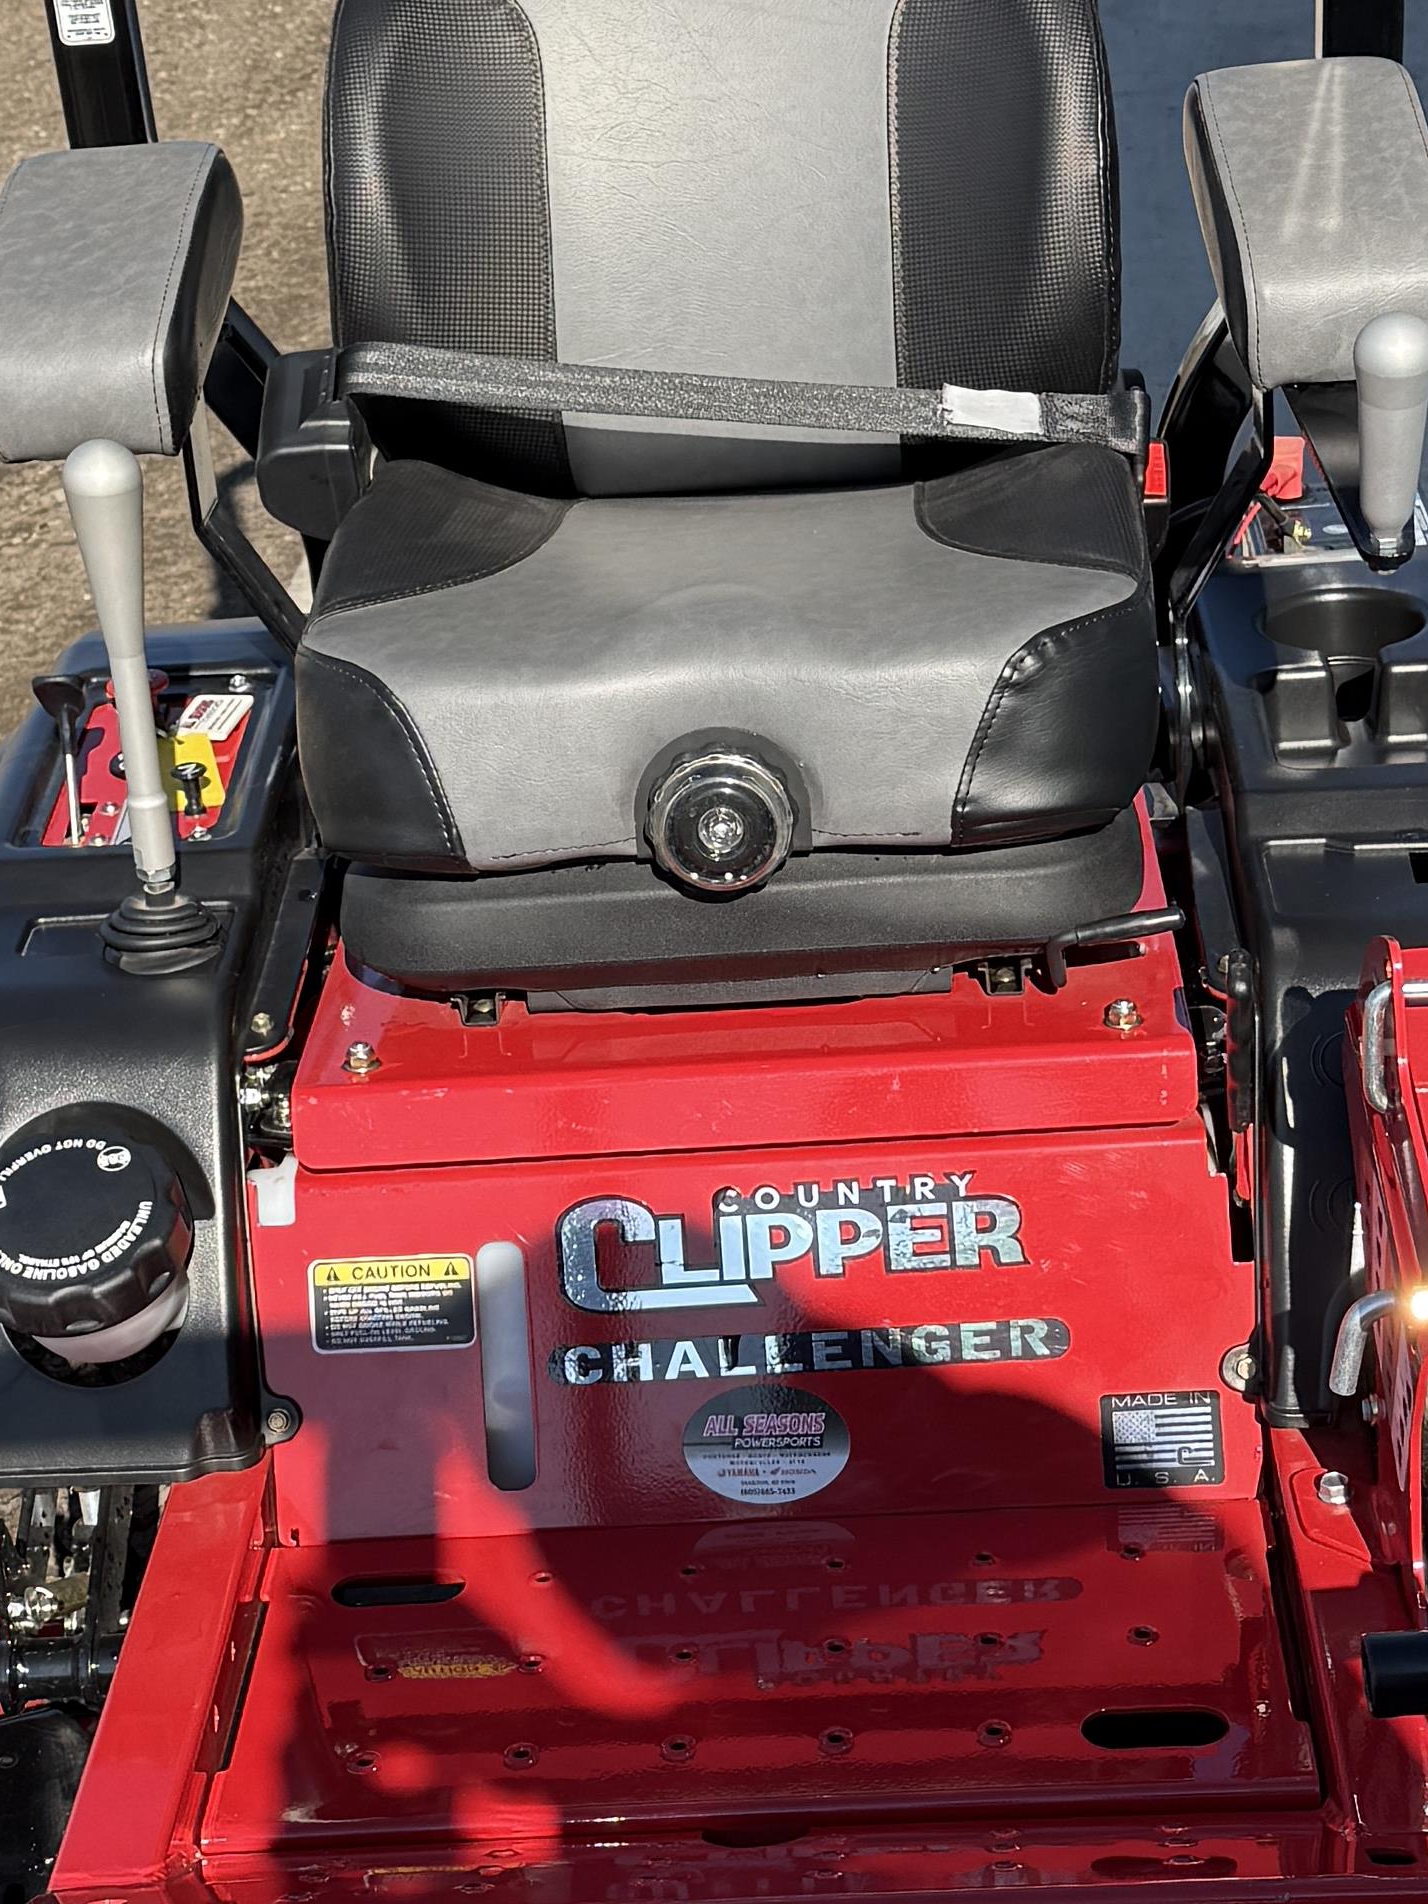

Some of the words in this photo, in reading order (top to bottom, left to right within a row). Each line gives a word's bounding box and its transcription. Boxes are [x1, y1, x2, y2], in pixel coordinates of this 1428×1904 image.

[55, 1138, 84, 1151] NOT
[85, 1139, 107, 1151] DO
[718, 1171, 976, 1213] COUNTRY
[100, 1201, 154, 1263] UNLEADED
[560, 1196, 1030, 1312] CLIPPER
[22, 1258, 101, 1281] GASOLINE
[352, 1264, 431, 1281] CAUTION
[563, 1319, 1052, 1385] CHALLENGER
[1112, 1393, 1178, 1408] MADE
[1189, 1392, 1211, 1404] IN
[703, 1414, 738, 1436] ALL
[742, 1413, 825, 1436] SEASONS
[734, 1436, 821, 1448] POWERSPORTS
